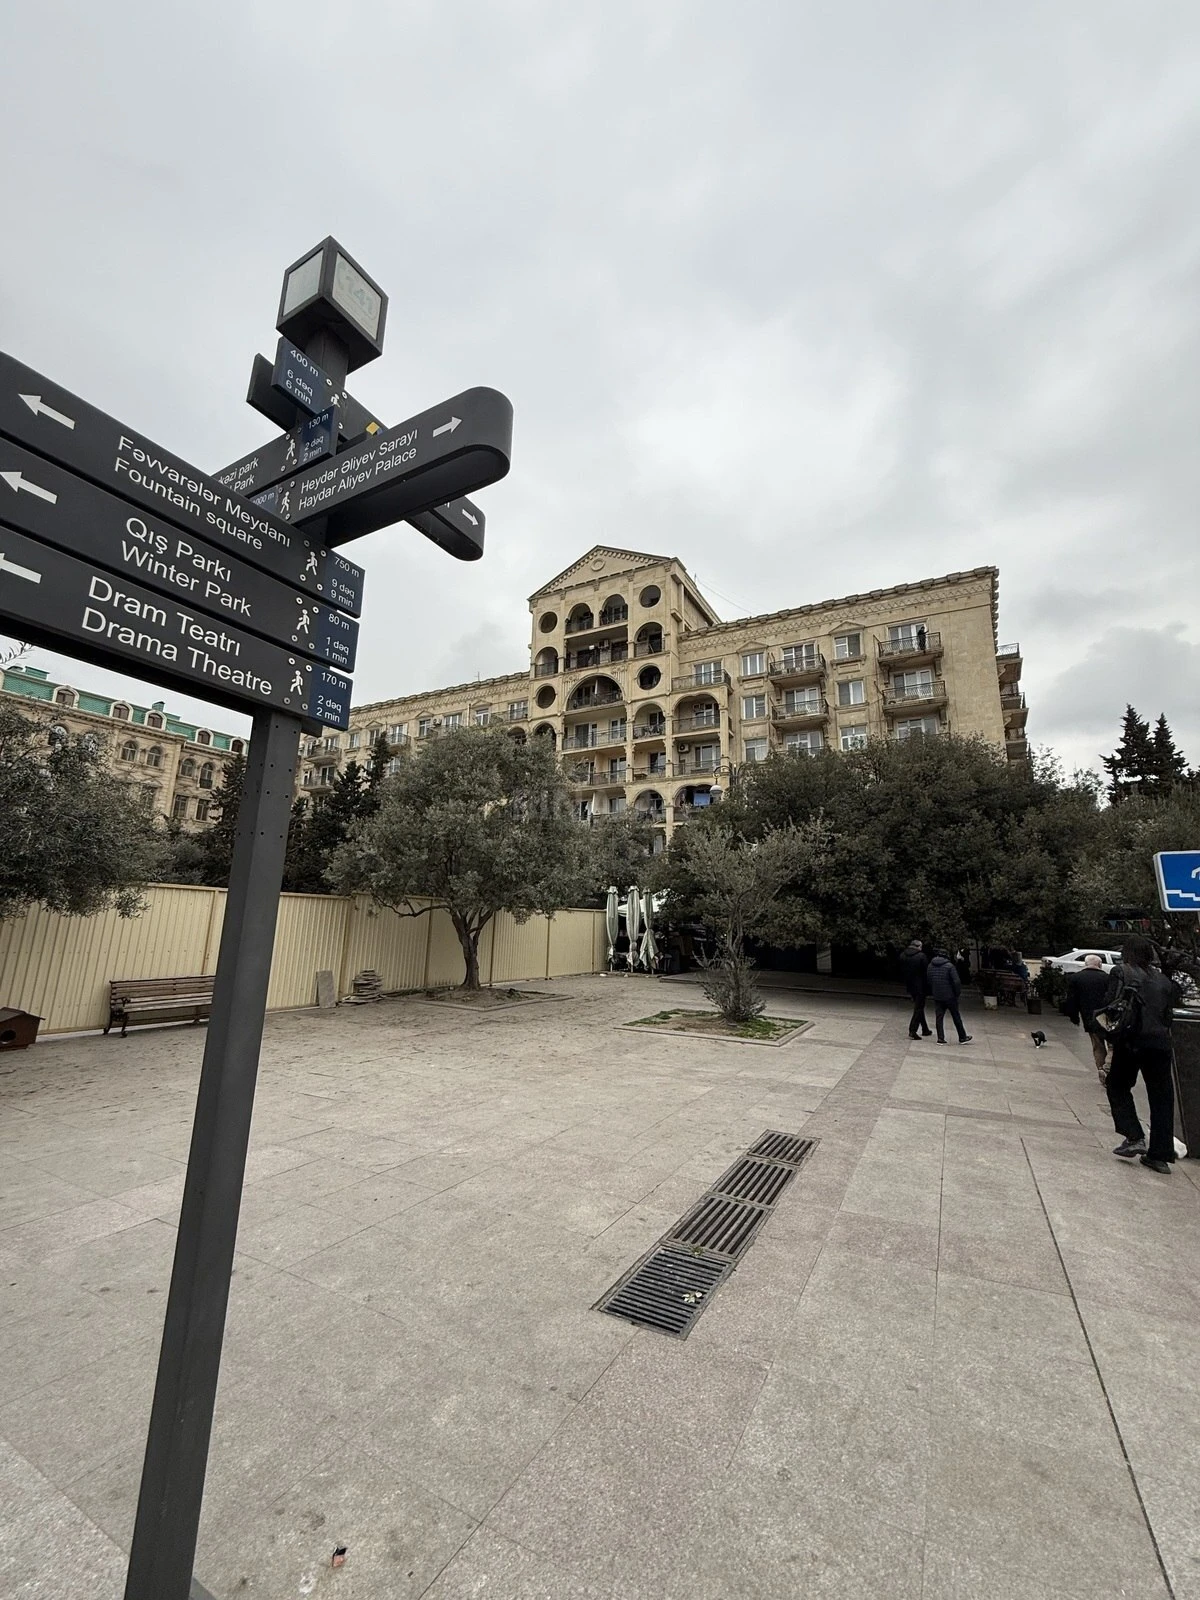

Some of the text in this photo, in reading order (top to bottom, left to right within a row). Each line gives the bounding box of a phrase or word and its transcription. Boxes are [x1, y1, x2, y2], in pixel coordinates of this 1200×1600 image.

[290, 349, 318, 377] 400 m
[286, 380, 312, 404] 6 min
[287, 369, 312, 396] 6 dəq
[309, 413, 329, 428] 130 m
[304, 442, 310, 451] 2
[304, 446, 322, 462] 2 min
[218, 457, 259, 486] kəzi park
[301, 429, 418, 494] Heydər Əliyev Sarayı
[234, 474, 255, 492] Park
[298, 448, 417, 511] Haydar Aliyev Palace
[114, 456, 263, 550] Fountain square
[118, 436, 291, 548] Fəvvarələr Meydanı
[126, 517, 232, 582] Qış Parkı
[335, 556, 360, 578] 750 m
[122, 540, 252, 617] Winter Park
[332, 578, 354, 600] 9 dəq
[330, 590, 354, 608] 9 min
[88, 576, 240, 656] Dram Teatrı
[328, 613, 350, 631] 80 m
[82, 606, 272, 695] Drama Theatre
[325, 648, 348, 665] 1 min
[326, 636, 350, 656] 1 dəq
[322, 672, 347, 690] 170 m
[316, 707, 340, 723] 2 min
[318, 695, 342, 714] 2 dəq
